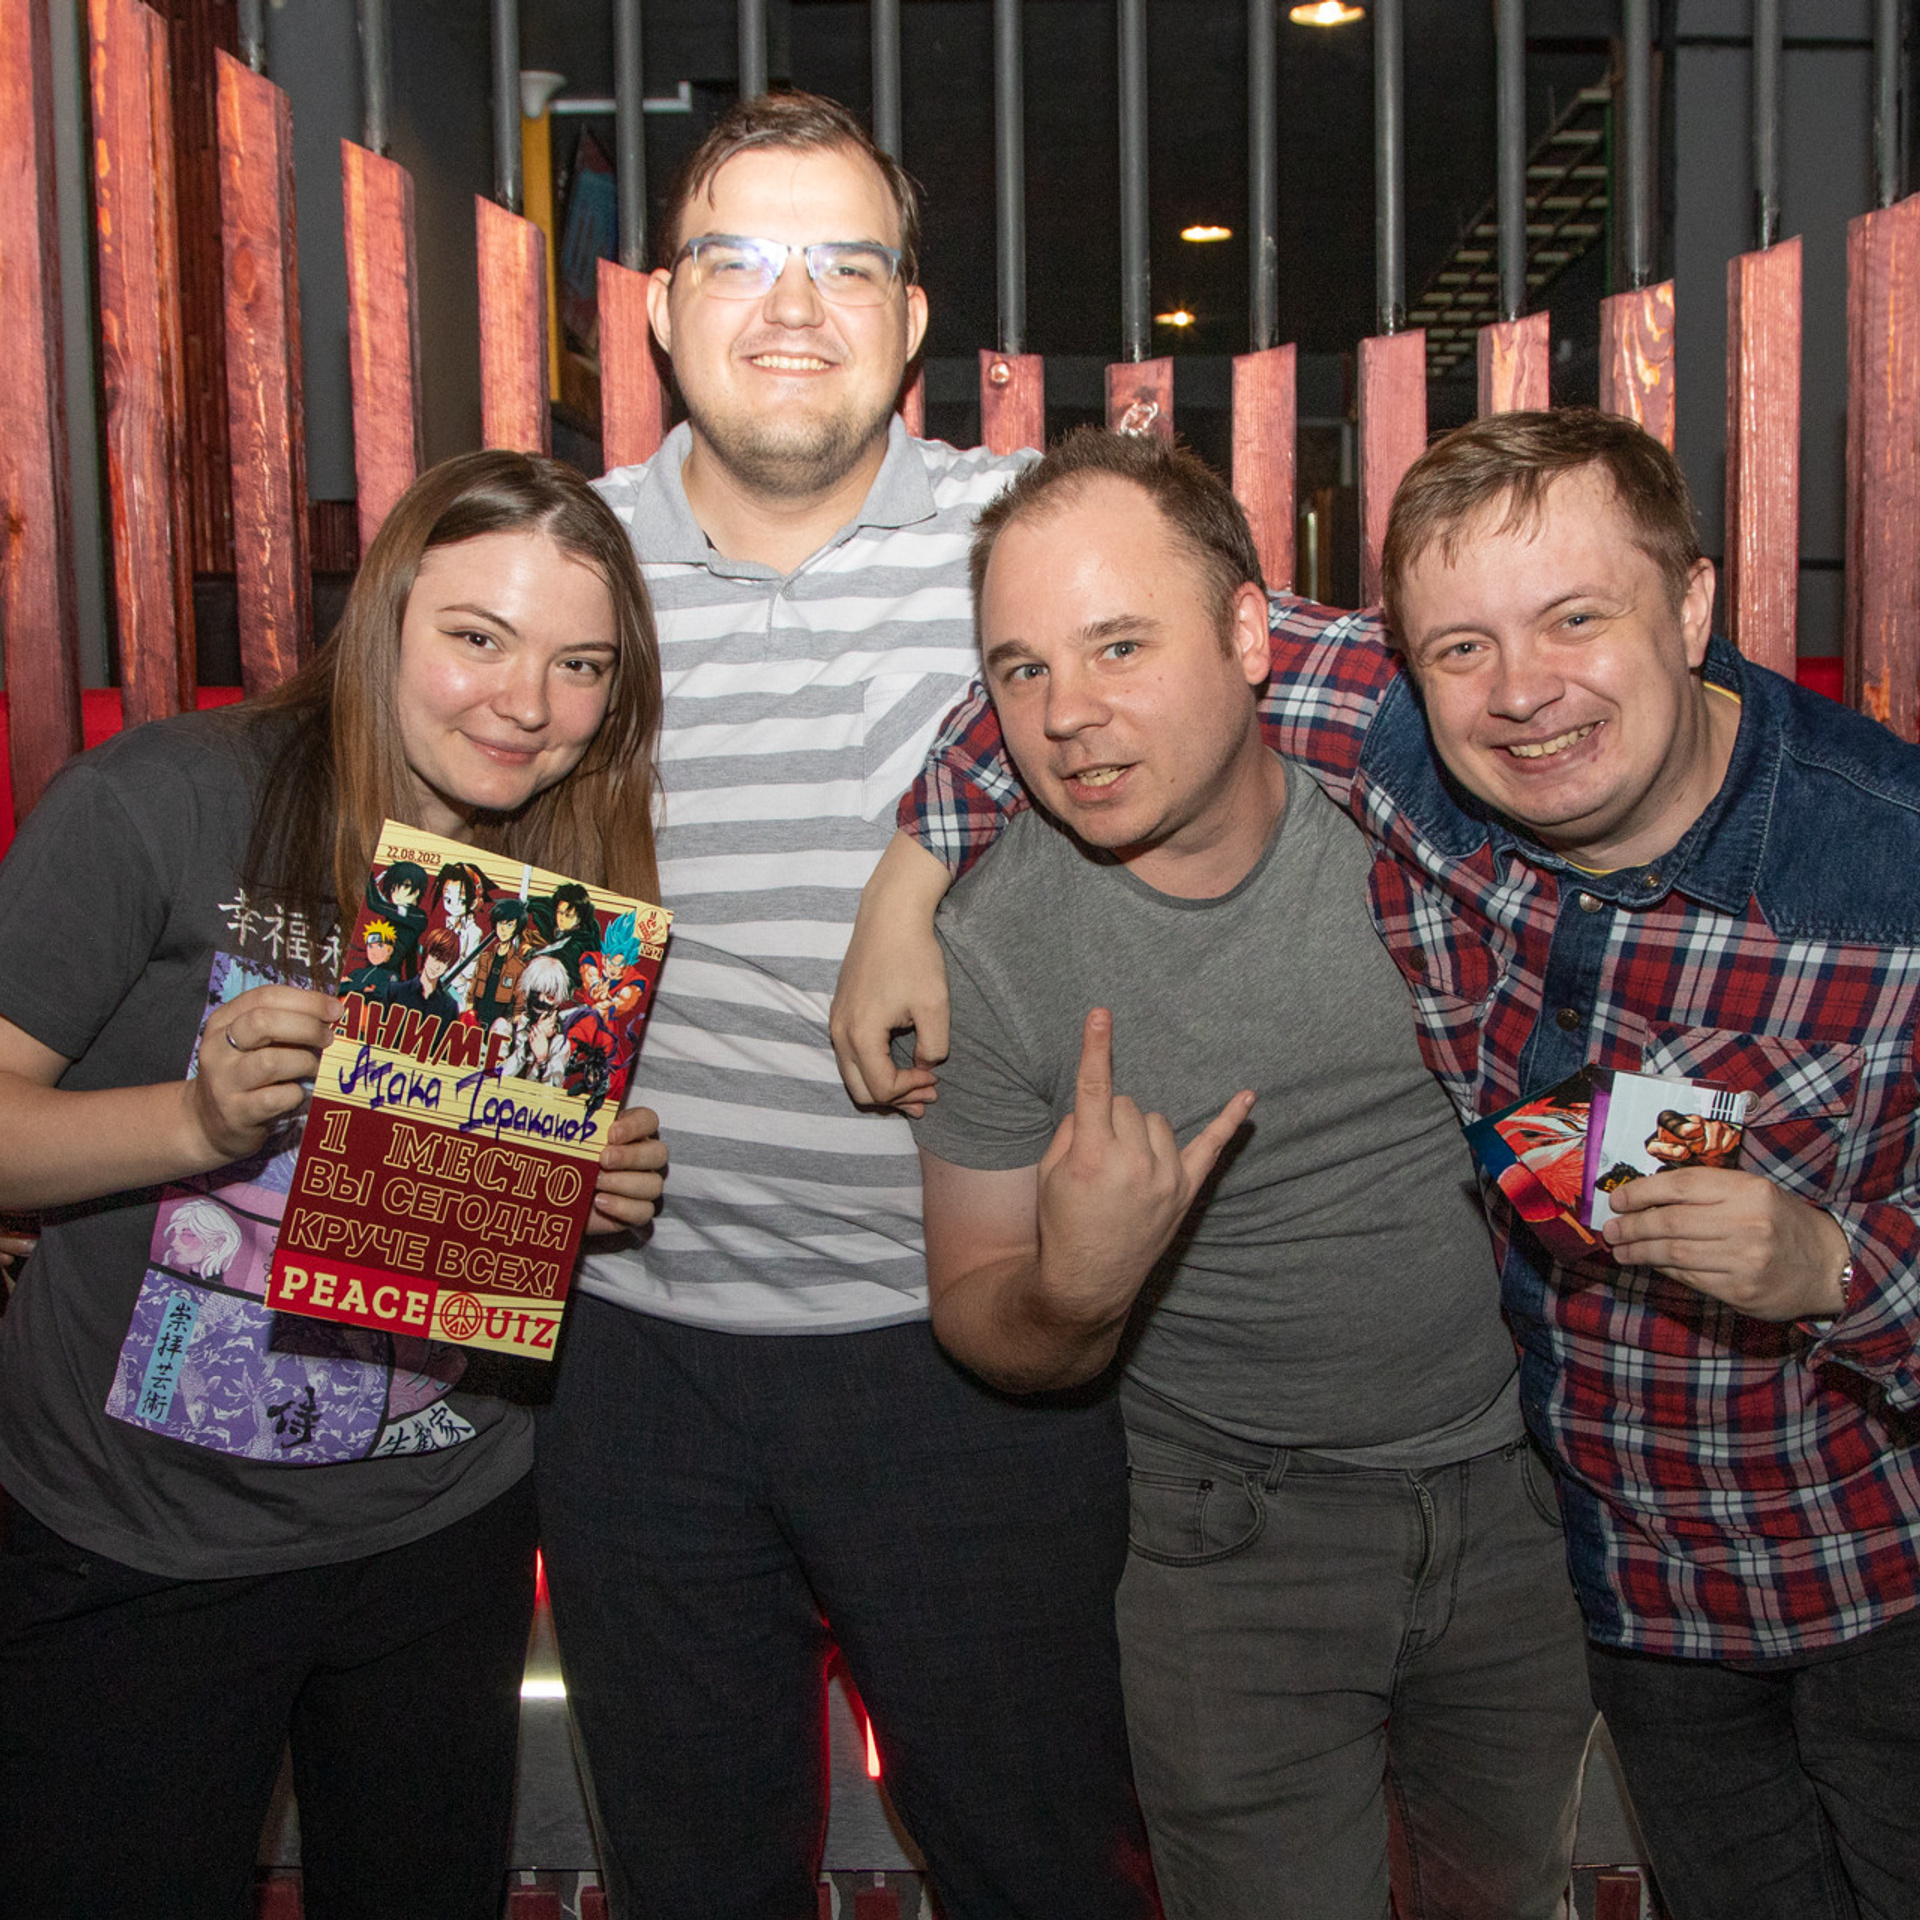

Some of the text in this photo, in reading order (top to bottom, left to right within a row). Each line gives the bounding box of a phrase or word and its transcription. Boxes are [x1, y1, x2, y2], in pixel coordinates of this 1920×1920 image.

[386, 845, 442, 864] 22.08.2023
[331, 991, 513, 1077] АНИМЕ
[320, 1110, 582, 1207] 1 МЕСТО
[301, 1156, 573, 1250] ВЫ СЕГОДНЯ
[278, 1265, 431, 1326] PEACE
[288, 1207, 430, 1271] КРУЧЕ
[435, 1240, 560, 1298] ВСЕХ!
[266, 1385, 323, 1448] 侍
